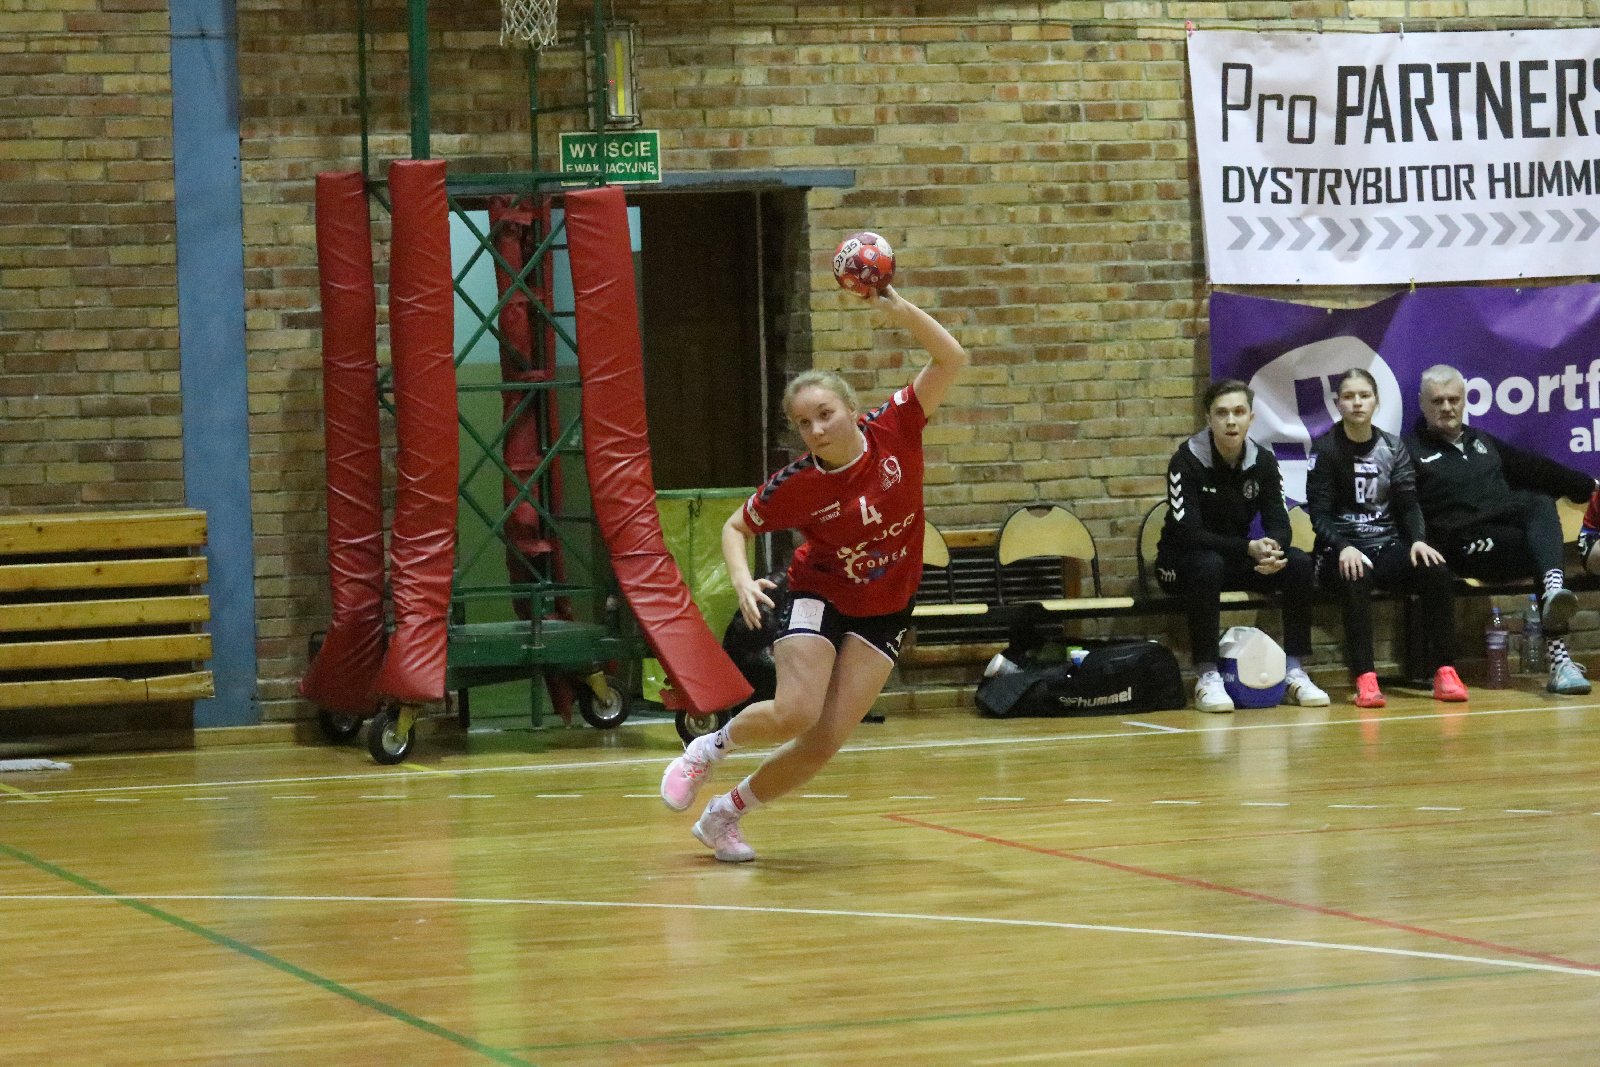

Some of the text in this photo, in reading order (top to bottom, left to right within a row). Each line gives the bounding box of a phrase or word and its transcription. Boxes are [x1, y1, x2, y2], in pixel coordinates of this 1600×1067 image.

[1221, 58, 1600, 145] Pro PARTNER
[1222, 163, 1477, 205] DYSTRYBUTOR
[1463, 358, 1600, 425] portf
[1354, 477, 1378, 503] 84
[859, 495, 882, 526] 4
[1078, 686, 1132, 707] hummel
